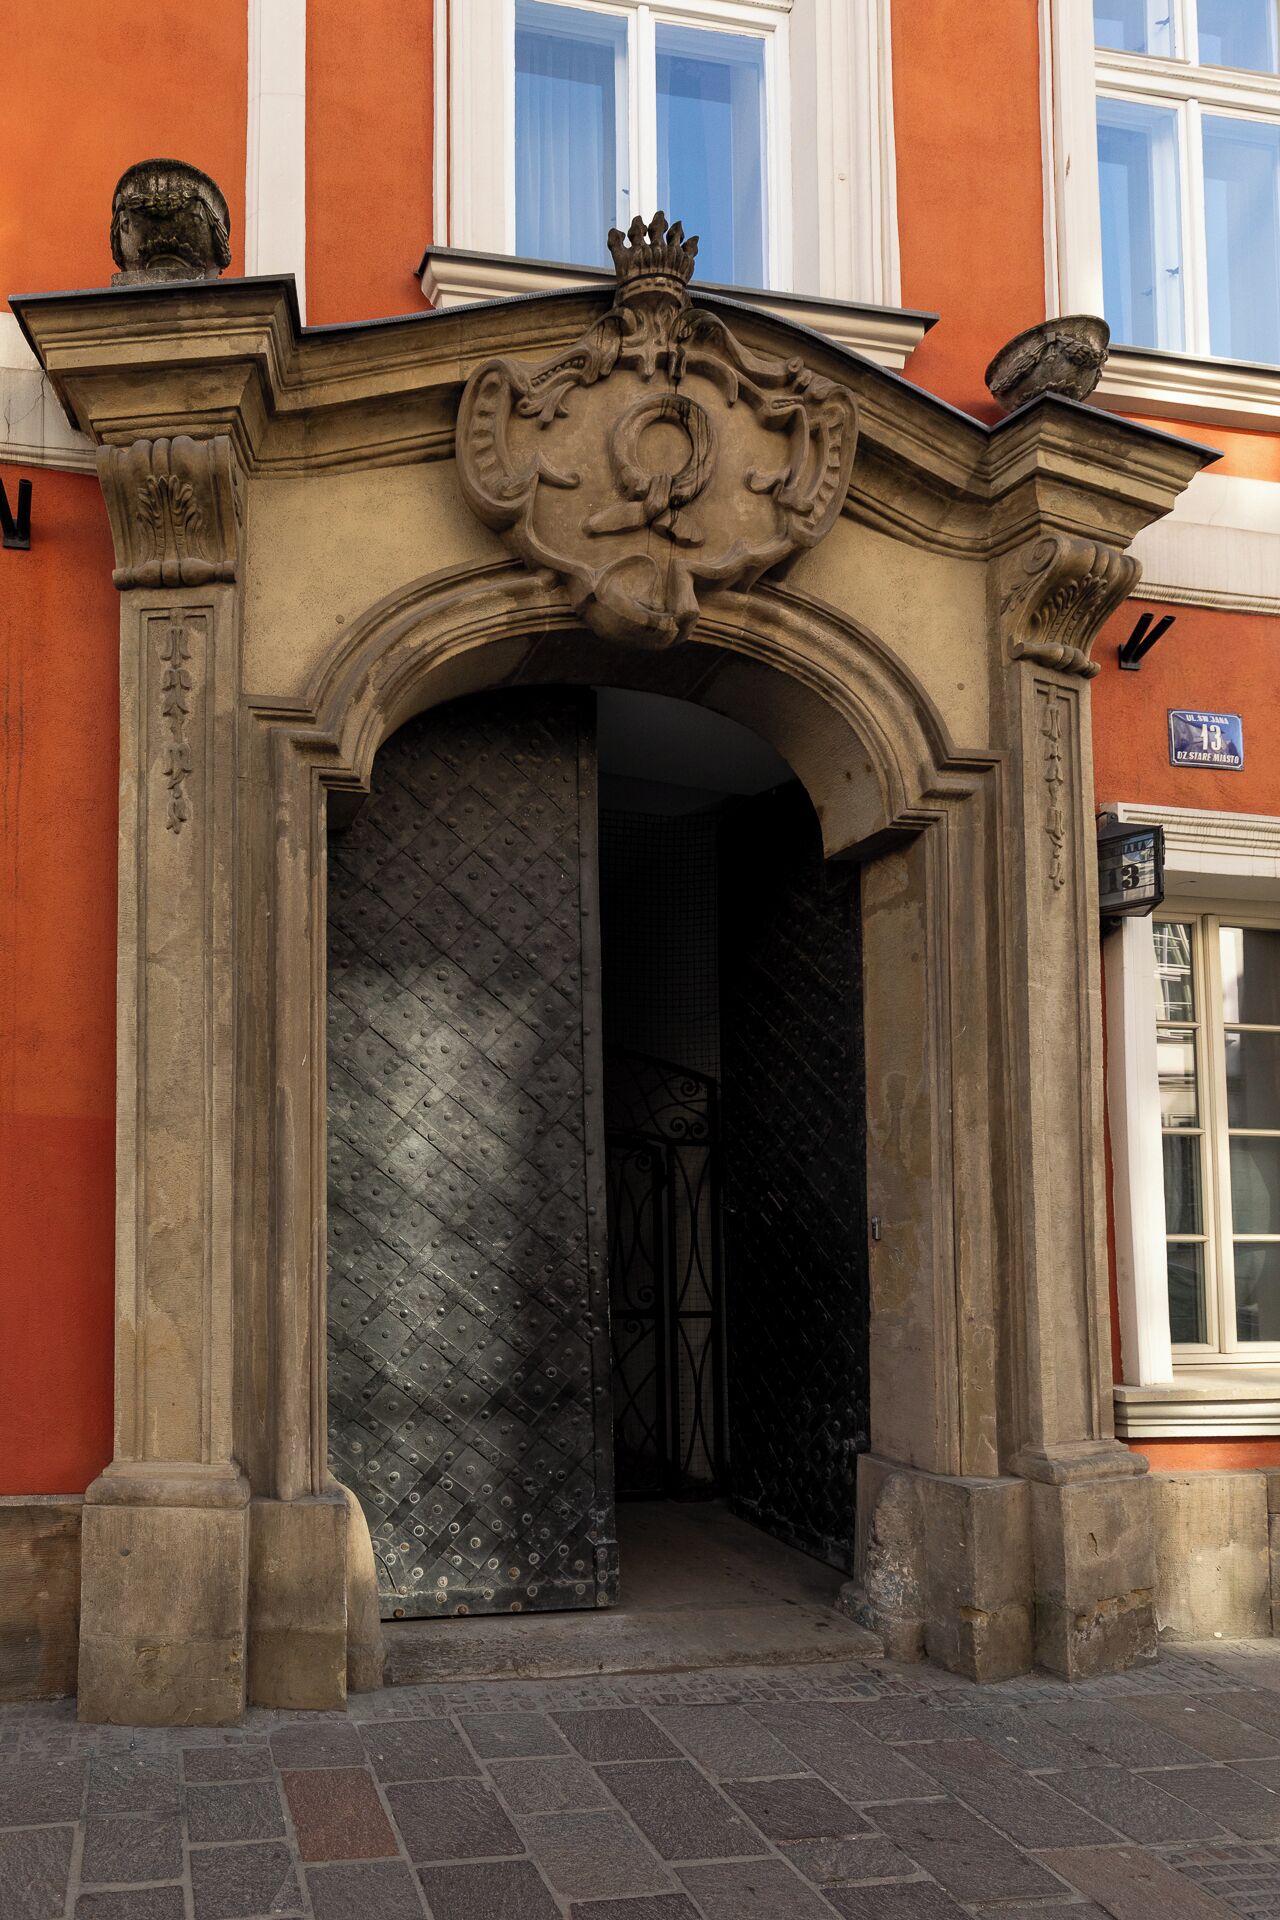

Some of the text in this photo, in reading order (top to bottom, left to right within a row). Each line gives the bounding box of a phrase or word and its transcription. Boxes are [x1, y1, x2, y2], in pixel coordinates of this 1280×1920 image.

[1200, 723, 1222, 751] 13
[1212, 753, 1240, 764] MIASTO
[1107, 863, 1139, 889] 13
